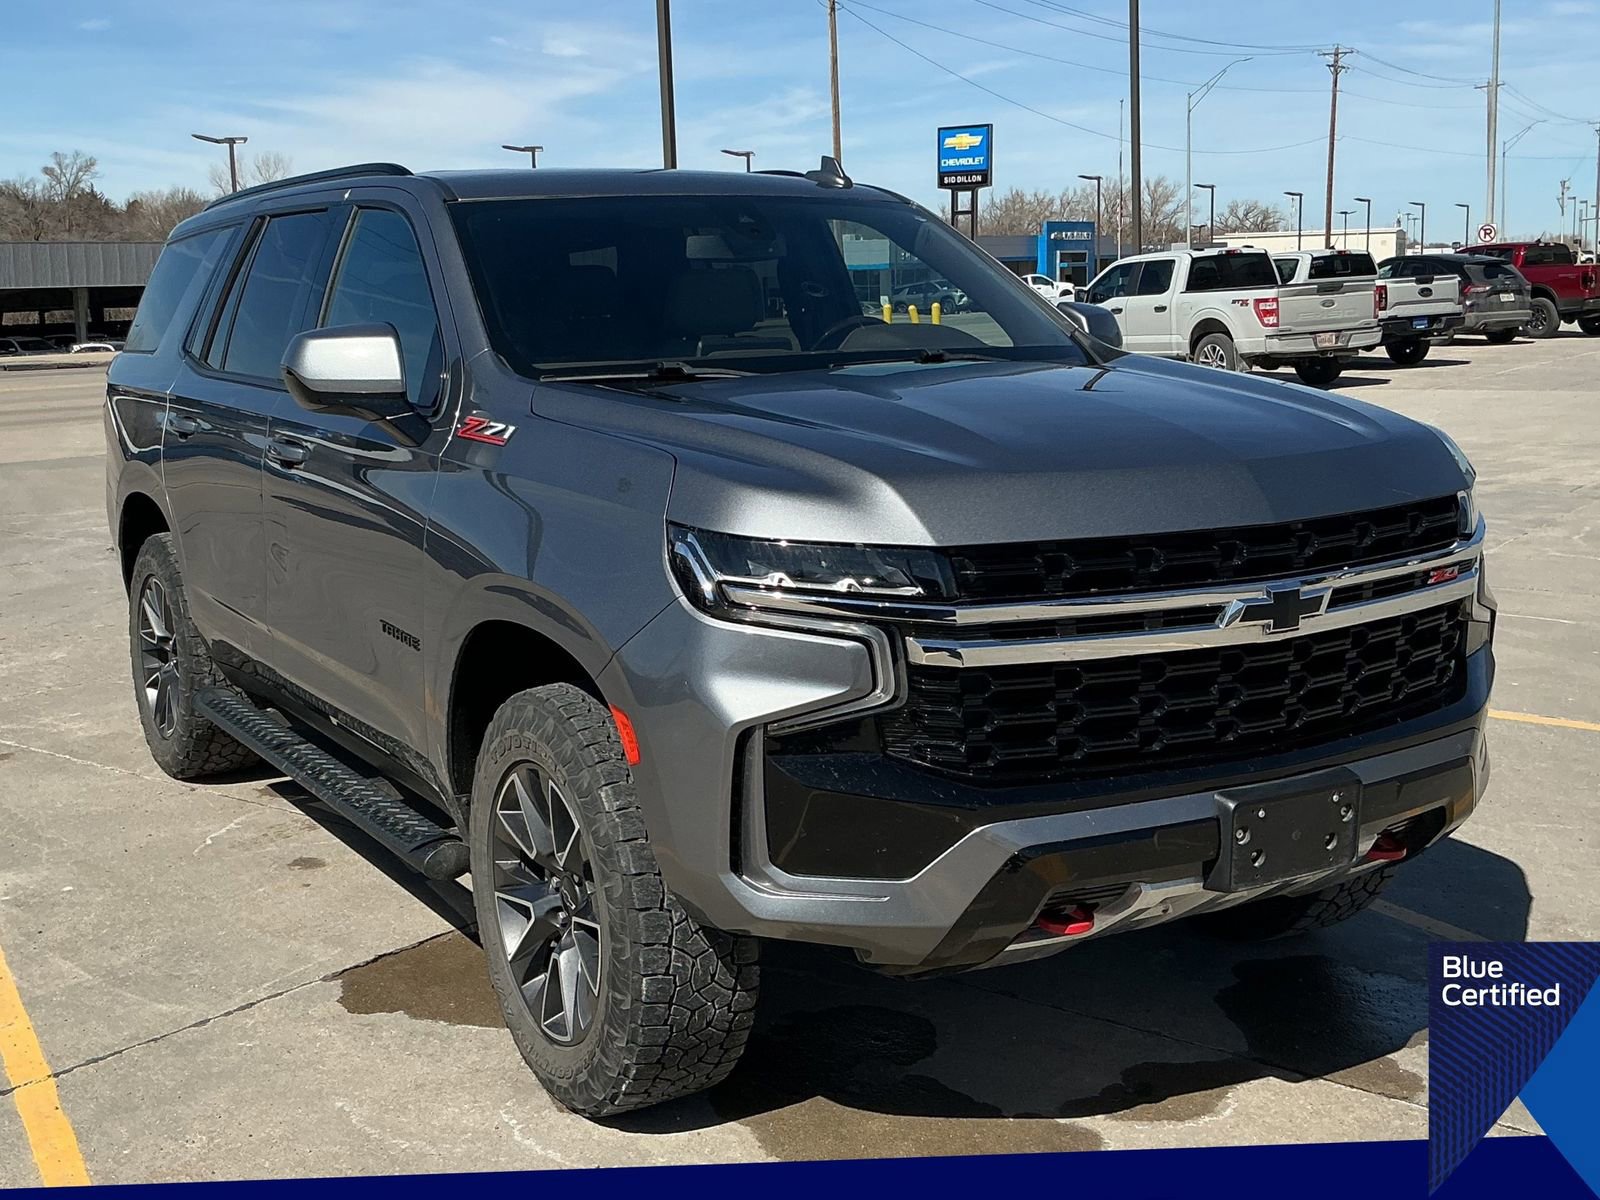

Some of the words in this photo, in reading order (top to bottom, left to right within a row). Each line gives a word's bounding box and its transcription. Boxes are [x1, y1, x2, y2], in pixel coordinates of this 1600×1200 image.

[941, 156, 985, 167] CHEVROLET
[943, 176, 956, 184] SID
[957, 174, 982, 183] DILLON
[457, 415, 516, 446] Z71
